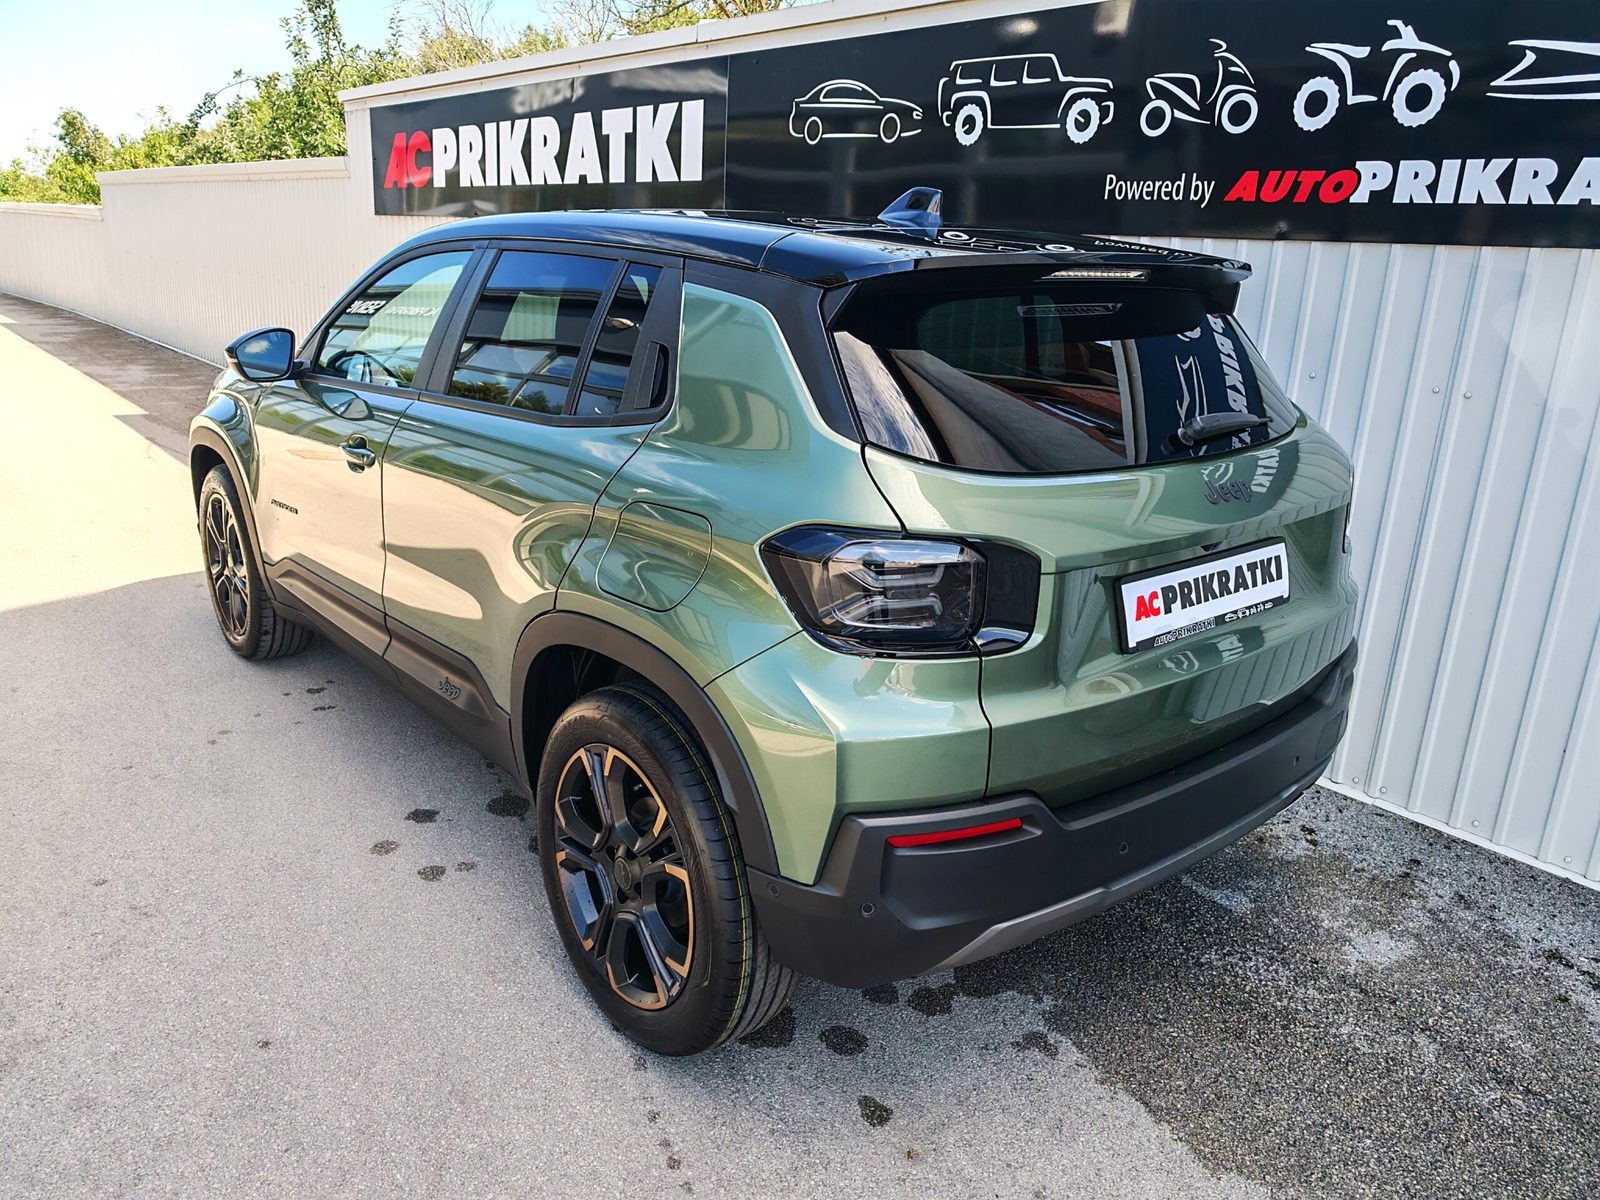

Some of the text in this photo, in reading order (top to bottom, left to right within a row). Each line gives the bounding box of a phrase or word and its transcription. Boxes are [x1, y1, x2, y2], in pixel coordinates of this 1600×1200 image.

[1104, 174, 1186, 201] Powered
[1189, 174, 1215, 208] by
[1204, 479, 1252, 505] Jeep
[1154, 618, 1216, 647] AUTOPRIKRATKI
